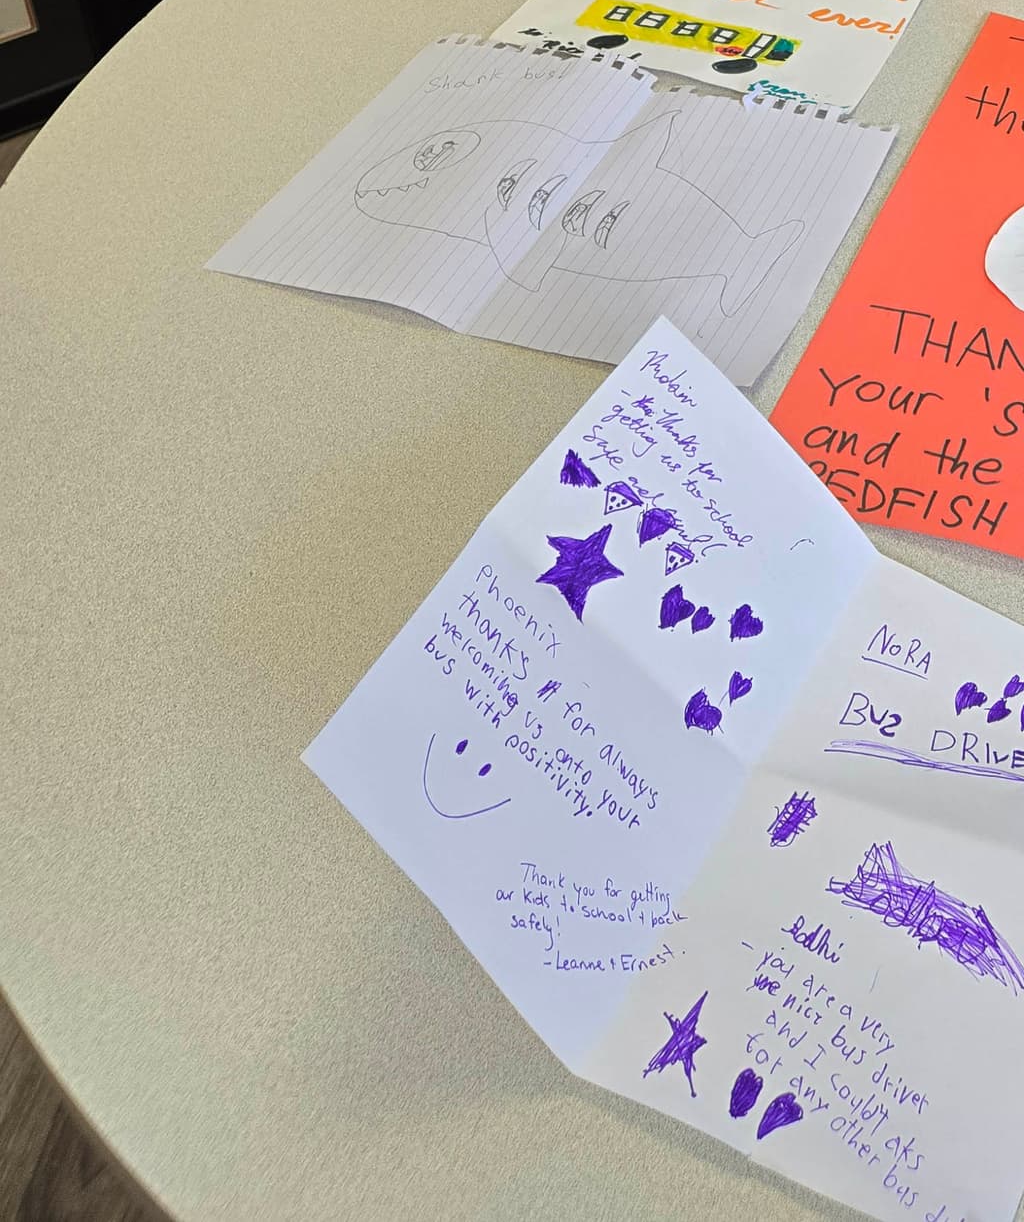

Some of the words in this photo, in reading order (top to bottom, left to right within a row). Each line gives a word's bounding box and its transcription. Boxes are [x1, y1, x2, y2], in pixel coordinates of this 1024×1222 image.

[802, 421, 895, 469] and
[925, 435, 1003, 488] the
[422, 635, 457, 676] bus
[464, 678, 502, 729] with
[458, 591, 530, 681] thanks
[562, 700, 596, 737] for
[555, 747, 593, 786] onto
[596, 789, 641, 830] your
[496, 888, 514, 902] our
[651, 911, 689, 929] back
[520, 862, 566, 889] Thank
[573, 882, 595, 906] you
[604, 877, 623, 898] for
[630, 881, 672, 917] getting
[766, 1010, 808, 1049] and
[803, 1043, 827, 1071] I
[803, 974, 835, 1009] are
[839, 1004, 852, 1020] a
[860, 1016, 896, 1056] very
[831, 1024, 868, 1066] bus
[871, 1063, 930, 1115] driver
[746, 1032, 783, 1075] for
[789, 1076, 831, 1113] any
[830, 1116, 881, 1167] other
[882, 1163, 919, 1208] bus
